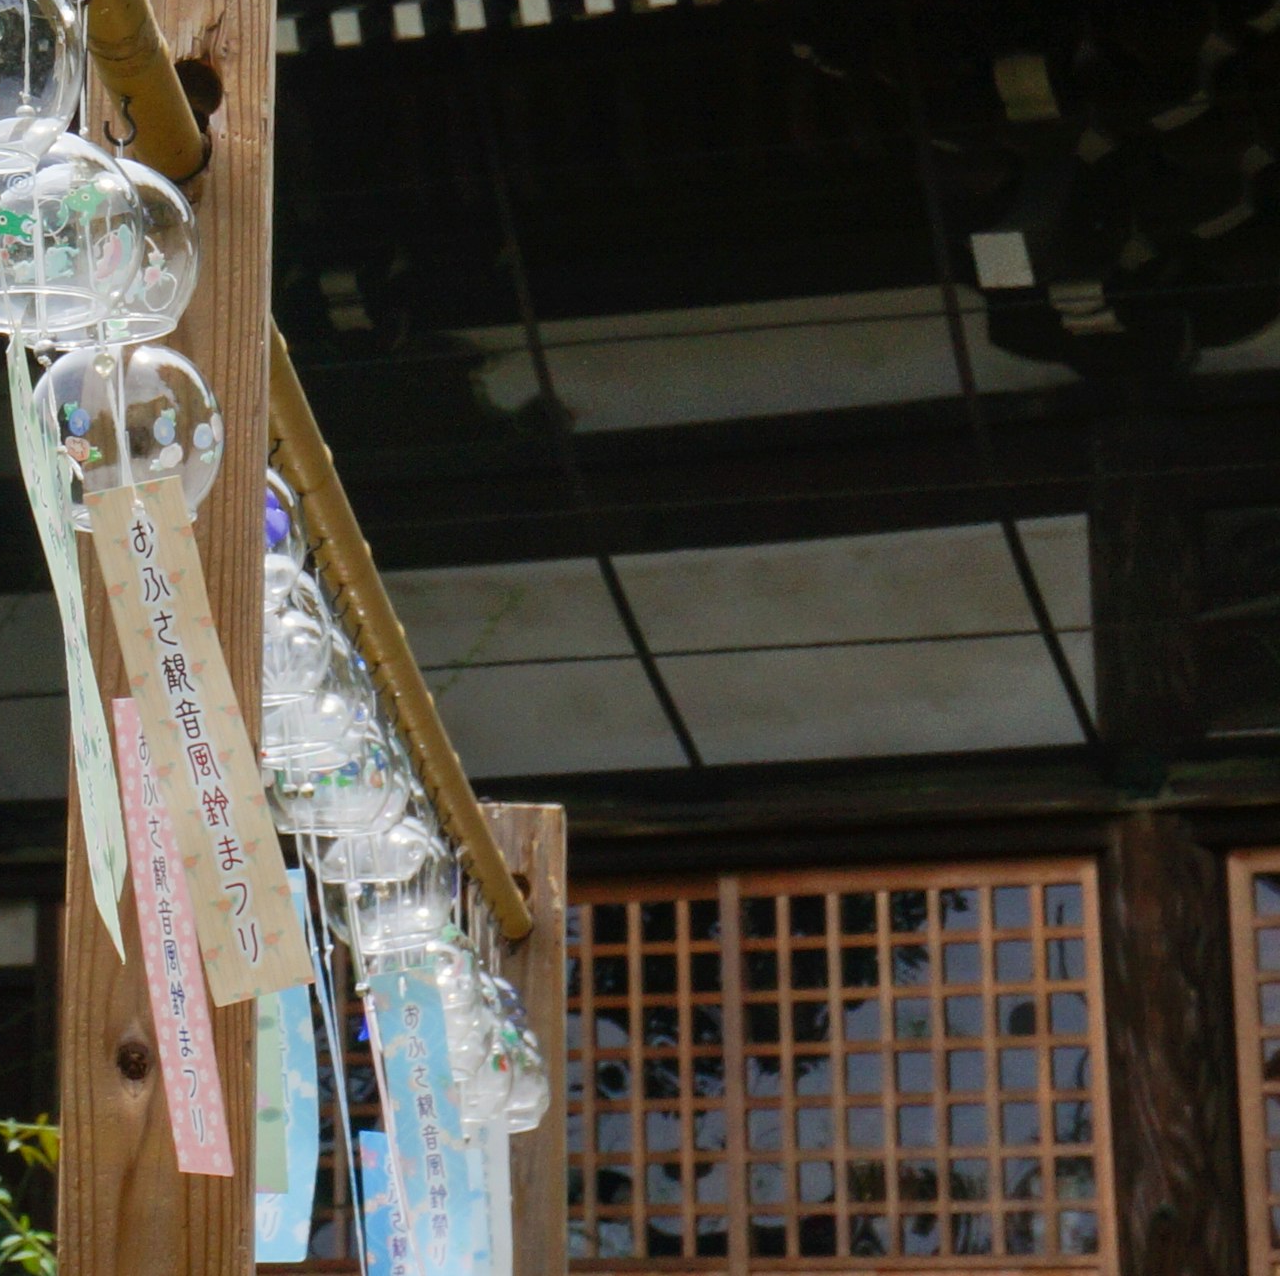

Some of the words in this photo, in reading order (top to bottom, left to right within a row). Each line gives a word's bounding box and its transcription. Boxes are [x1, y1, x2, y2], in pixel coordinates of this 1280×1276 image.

[130, 515, 261, 965] おふさ観音風鈴まつり
[403, 1005, 450, 1268] おふさ観音風鈴祭り
